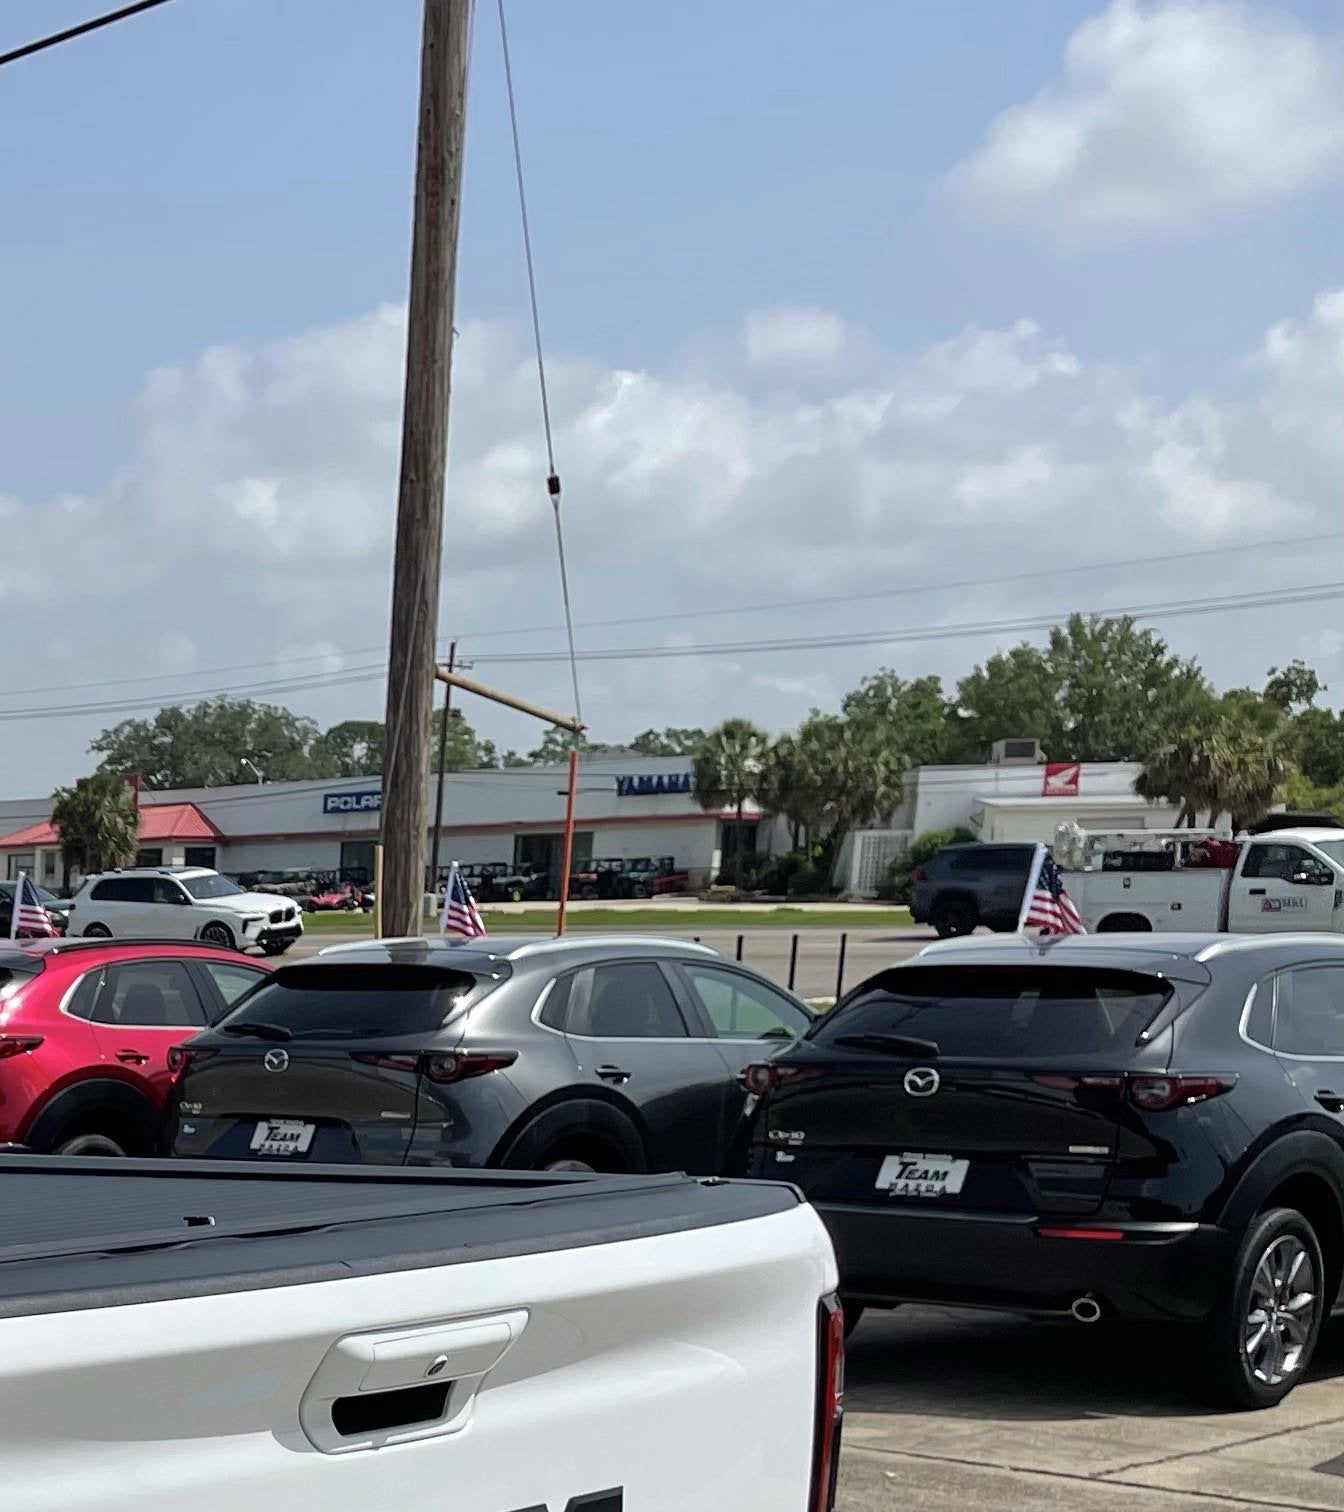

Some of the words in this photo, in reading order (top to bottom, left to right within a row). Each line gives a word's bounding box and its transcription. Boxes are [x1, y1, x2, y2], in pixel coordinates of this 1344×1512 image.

[615, 773, 692, 796] YAMAHA
[327, 794, 382, 811] POLAR
[264, 1126, 301, 1142] TEAM
[896, 1162, 949, 1181] TEAM
